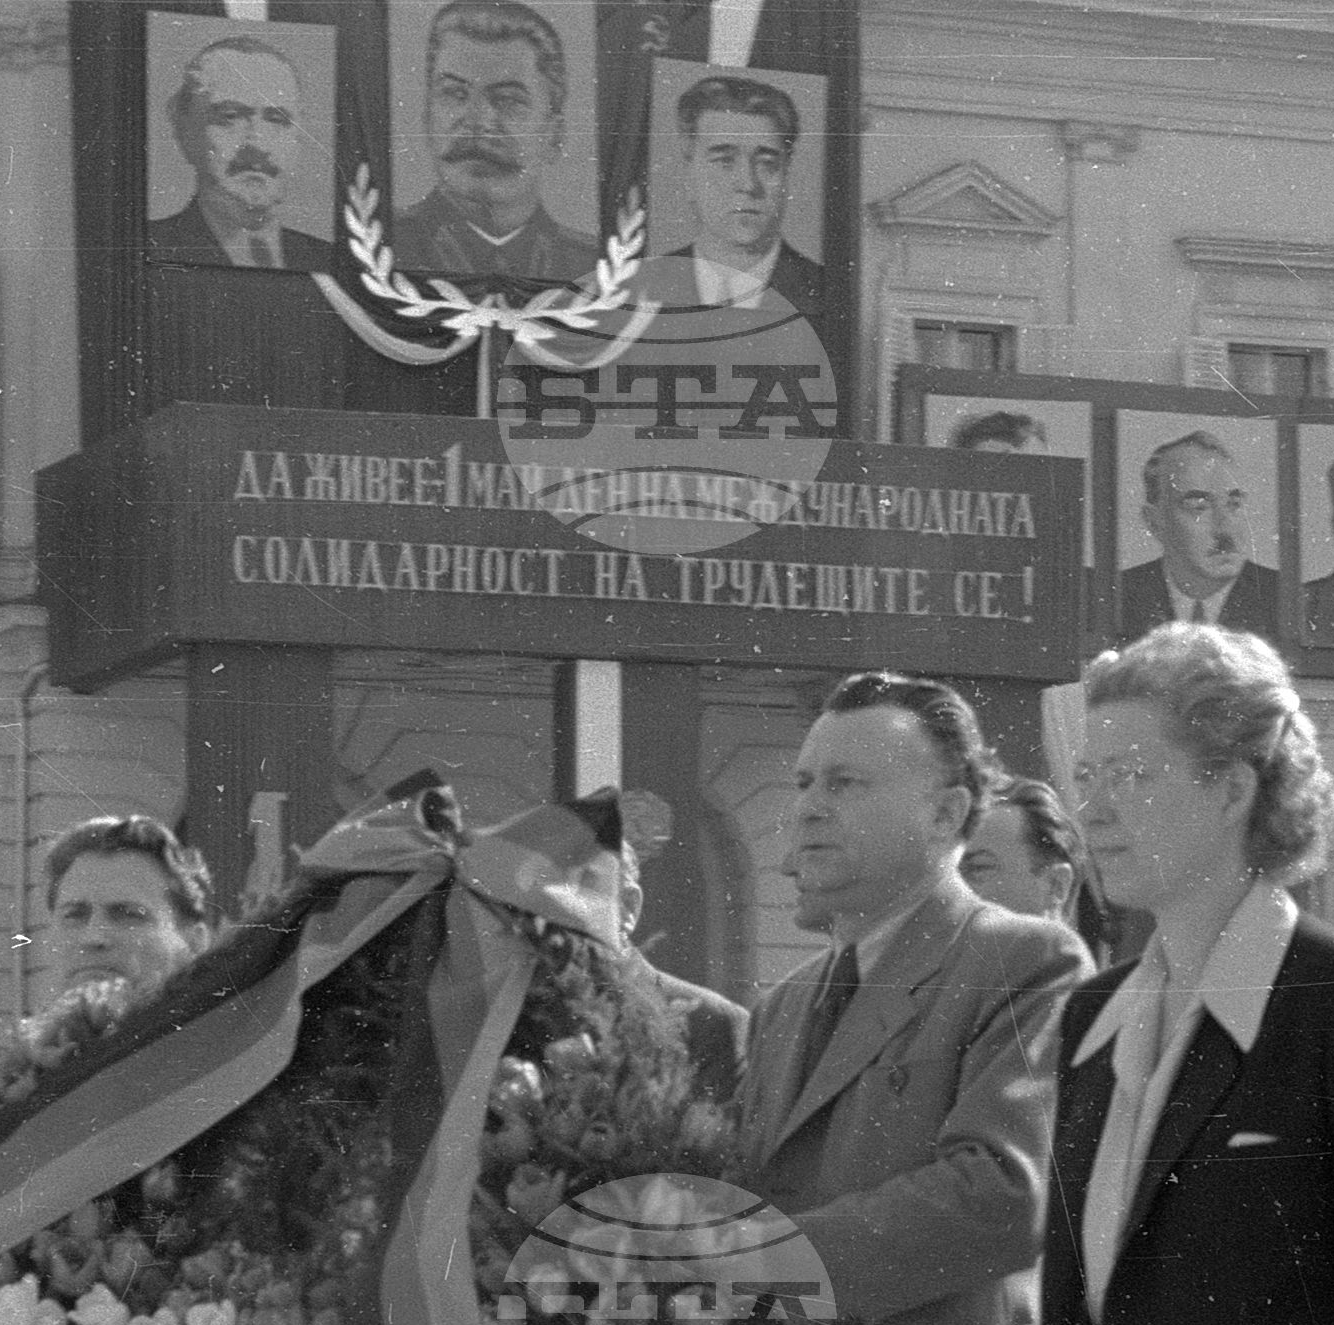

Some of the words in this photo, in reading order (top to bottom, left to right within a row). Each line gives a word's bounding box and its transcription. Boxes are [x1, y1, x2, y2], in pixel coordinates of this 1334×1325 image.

[234, 451, 292, 500] ДА
[555, 467, 629, 515] ДЕН
[638, 471, 689, 518] НА
[696, 475, 1036, 538] МЕЖДУНАРОДНАТА
[233, 535, 565, 597] СОЛИДАРНОСТ
[594, 551, 648, 600] НА
[673, 556, 930, 616] ТРУДЕЩИТЕ
